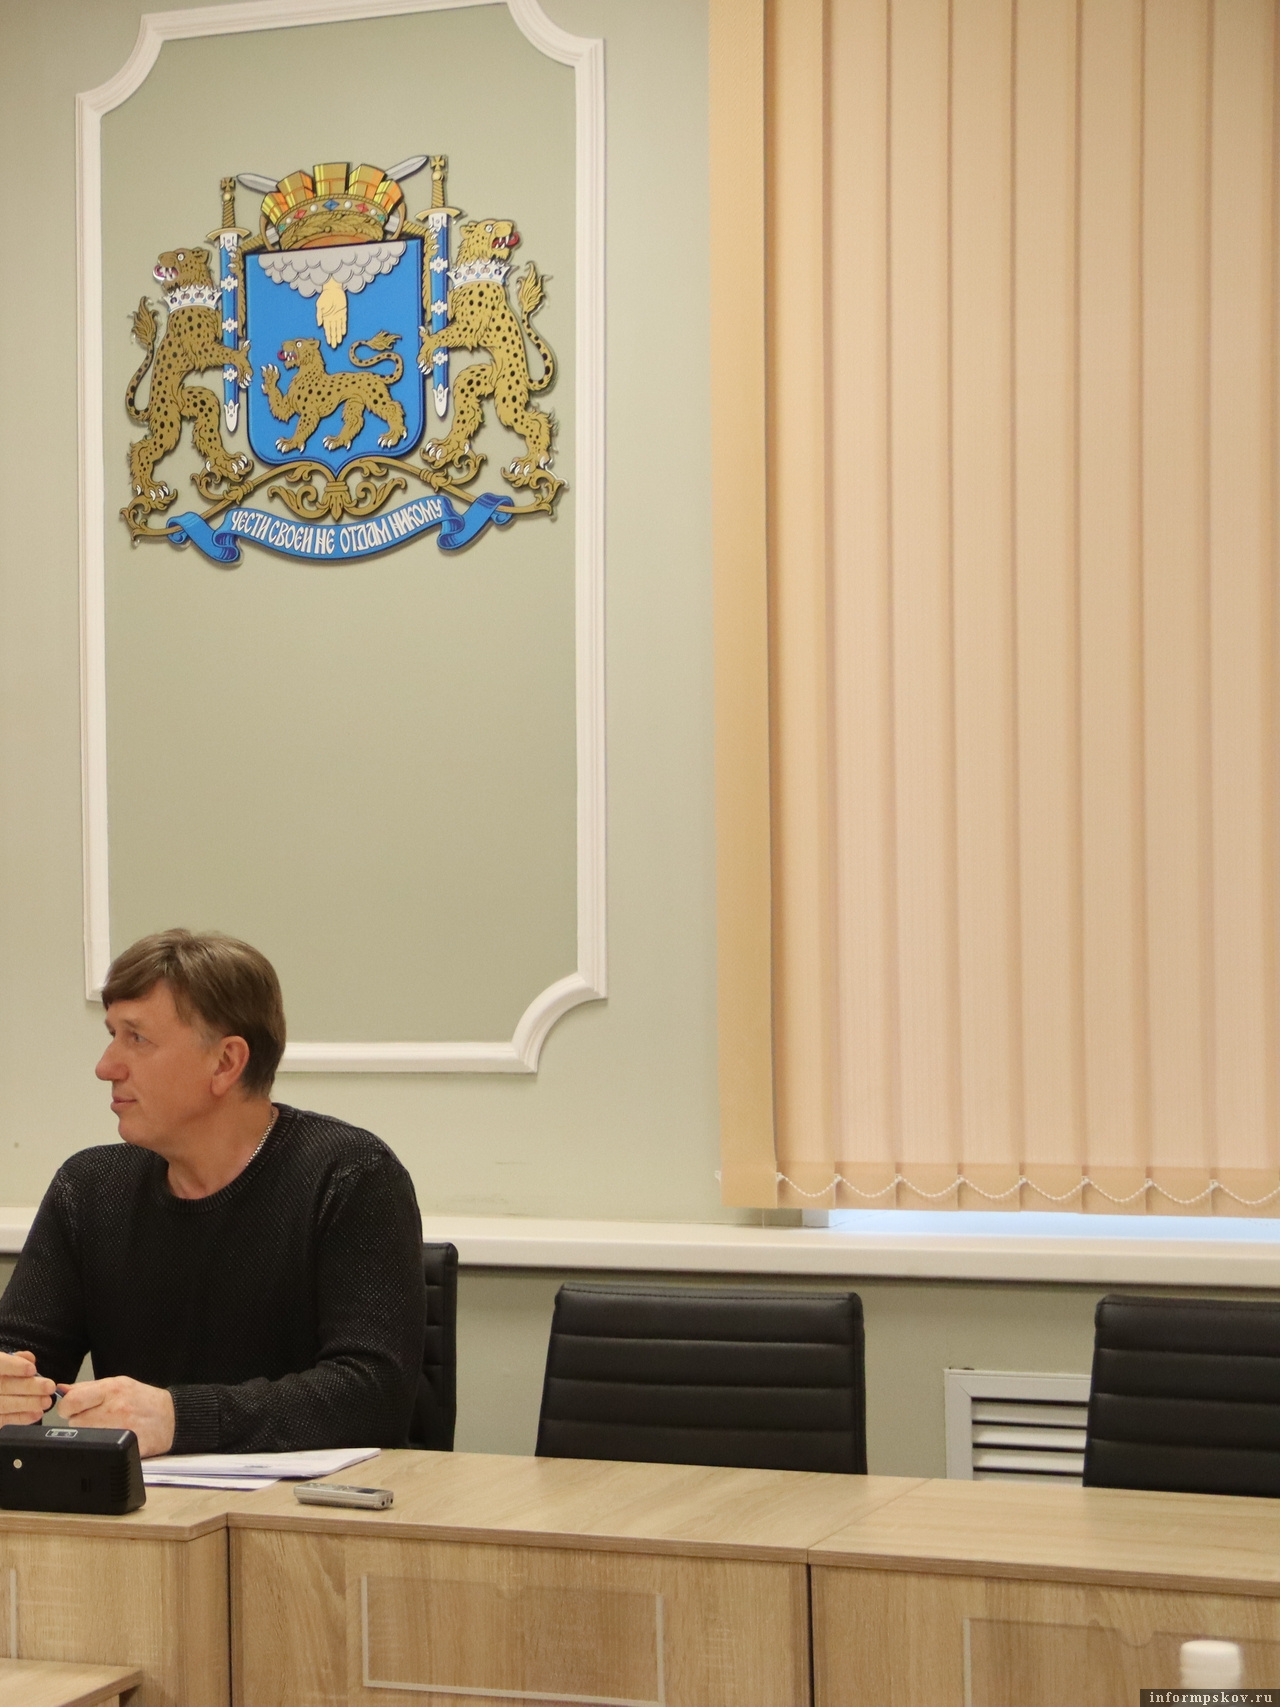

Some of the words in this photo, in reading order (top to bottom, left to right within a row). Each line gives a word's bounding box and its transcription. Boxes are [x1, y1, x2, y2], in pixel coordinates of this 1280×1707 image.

[231, 511, 270, 540] ЧЕСТИ
[269, 517, 311, 553] СВОЕЙ
[316, 528, 335, 554] НЕ
[339, 518, 392, 553] ОТДАМ
[390, 499, 442, 538] НИКОМУ
